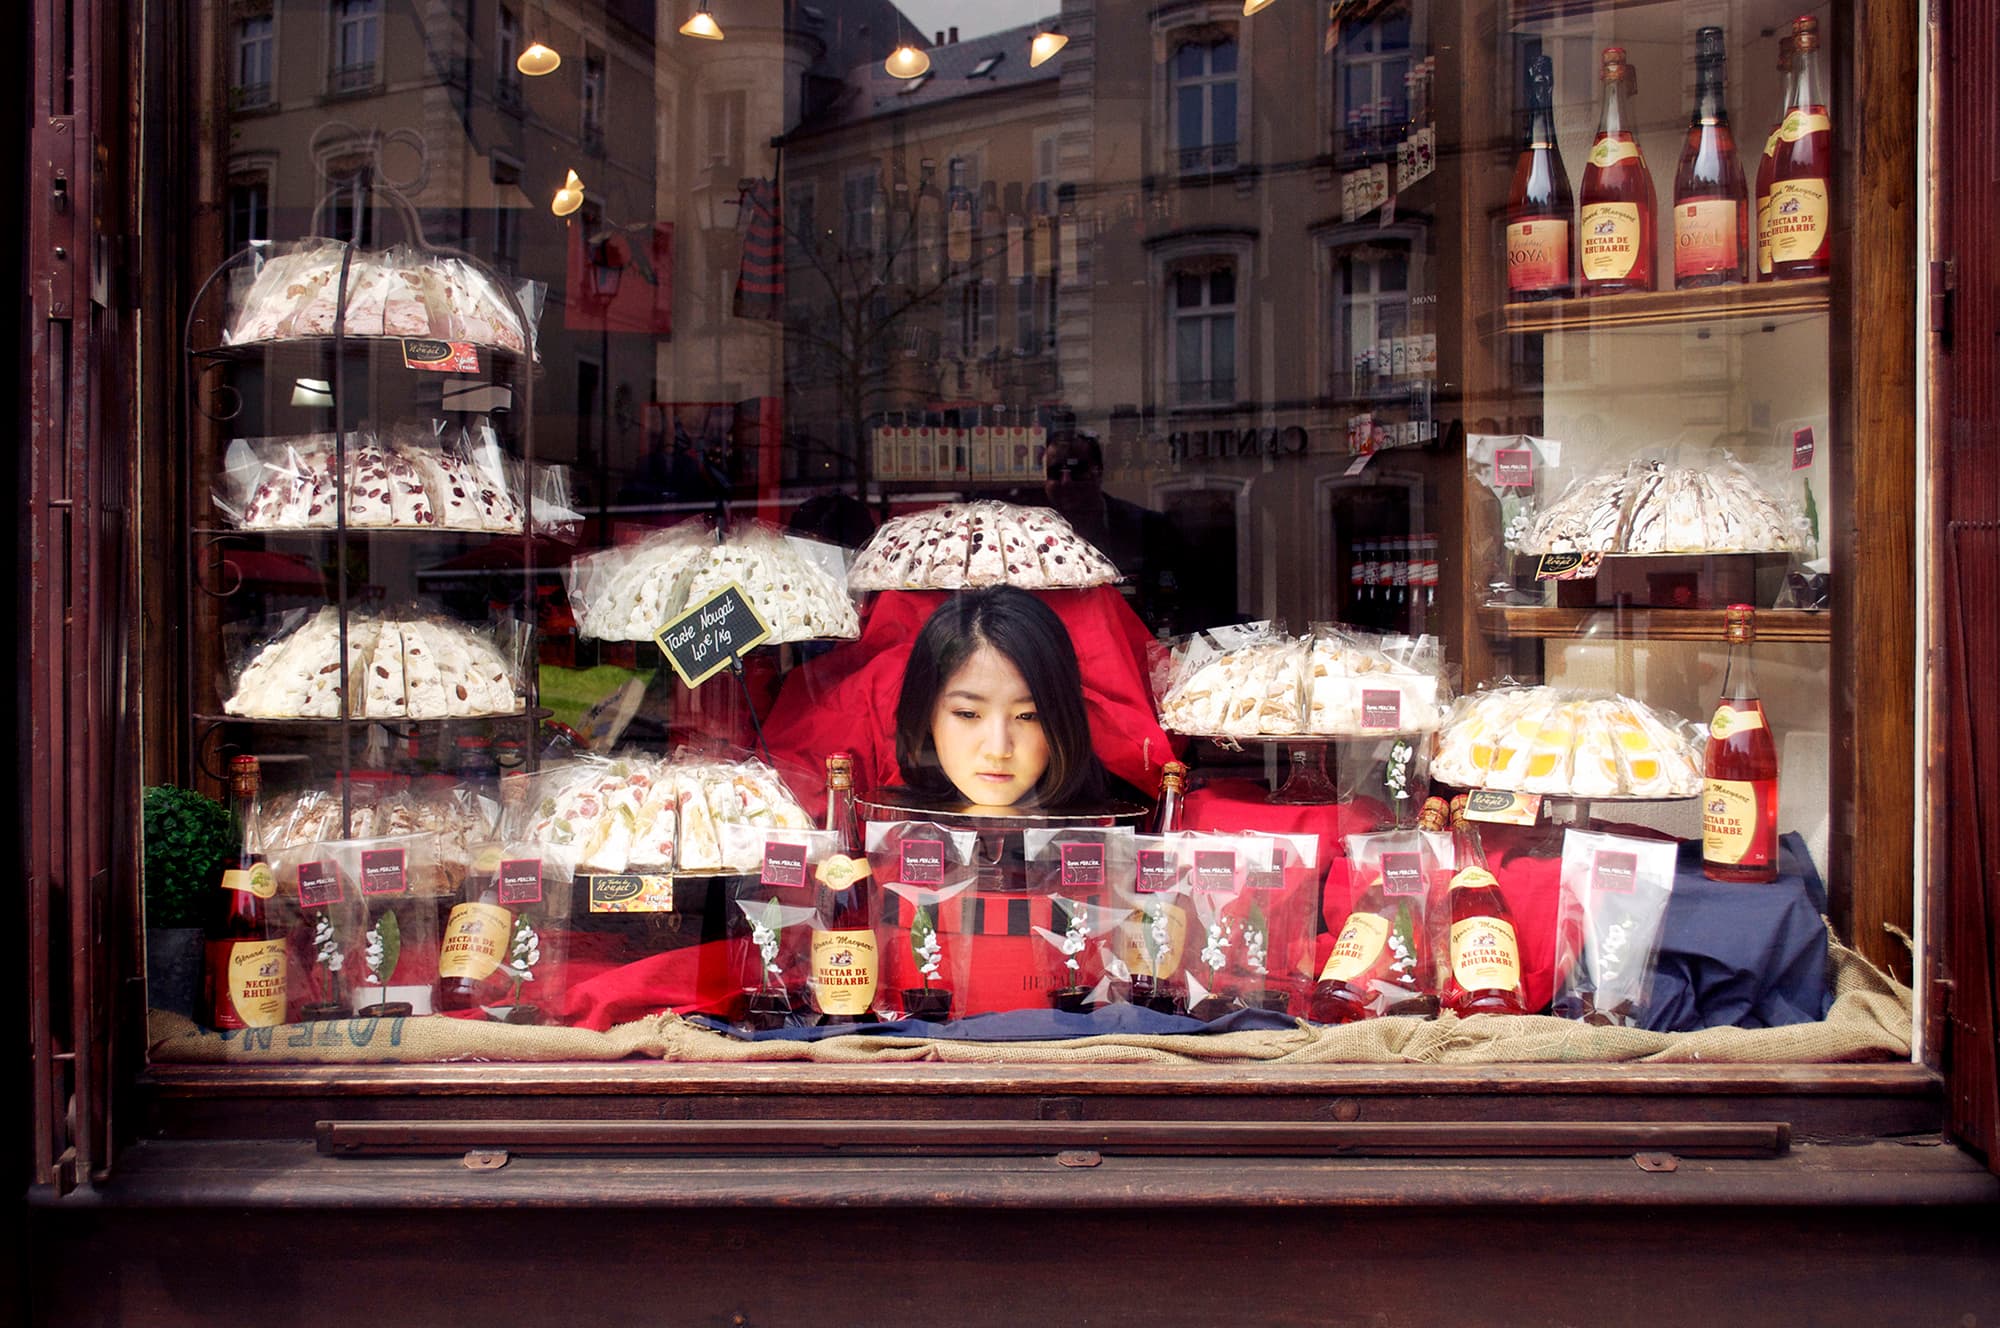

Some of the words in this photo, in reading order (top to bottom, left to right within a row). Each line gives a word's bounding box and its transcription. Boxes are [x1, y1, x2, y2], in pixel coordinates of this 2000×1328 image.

[1773, 216, 1798, 226] NECTAR
[1801, 215, 1813, 223] DE
[1772, 224, 1816, 236] RHUBARBE
[1586, 237, 1614, 246] NECTAR
[1681, 229, 1723, 247] OYAL
[1585, 245, 1630, 255] RHUBARBE
[664, 625, 696, 651] Tarte
[700, 595, 735, 630] Nougat
[1704, 815, 1725, 825] ECTAR
[1728, 818, 1740, 826] DE
[1704, 823, 1742, 835] HUBARBE
[597, 883, 630, 893] Nougat
[448, 936, 480, 945] NECTAR
[483, 938, 495, 947] DE
[445, 943, 496, 956] RHUBARBE
[1462, 949, 1497, 959] NECTAR
[1500, 950, 1511, 958] DE
[235, 948, 264, 966] Gérard
[1461, 956, 1513, 968] RHUBARBE
[820, 968, 852, 976] NECTAR
[855, 967, 867, 976] DE
[246, 978, 279, 988] NECTAR
[819, 976, 869, 986] RHUBARBE
